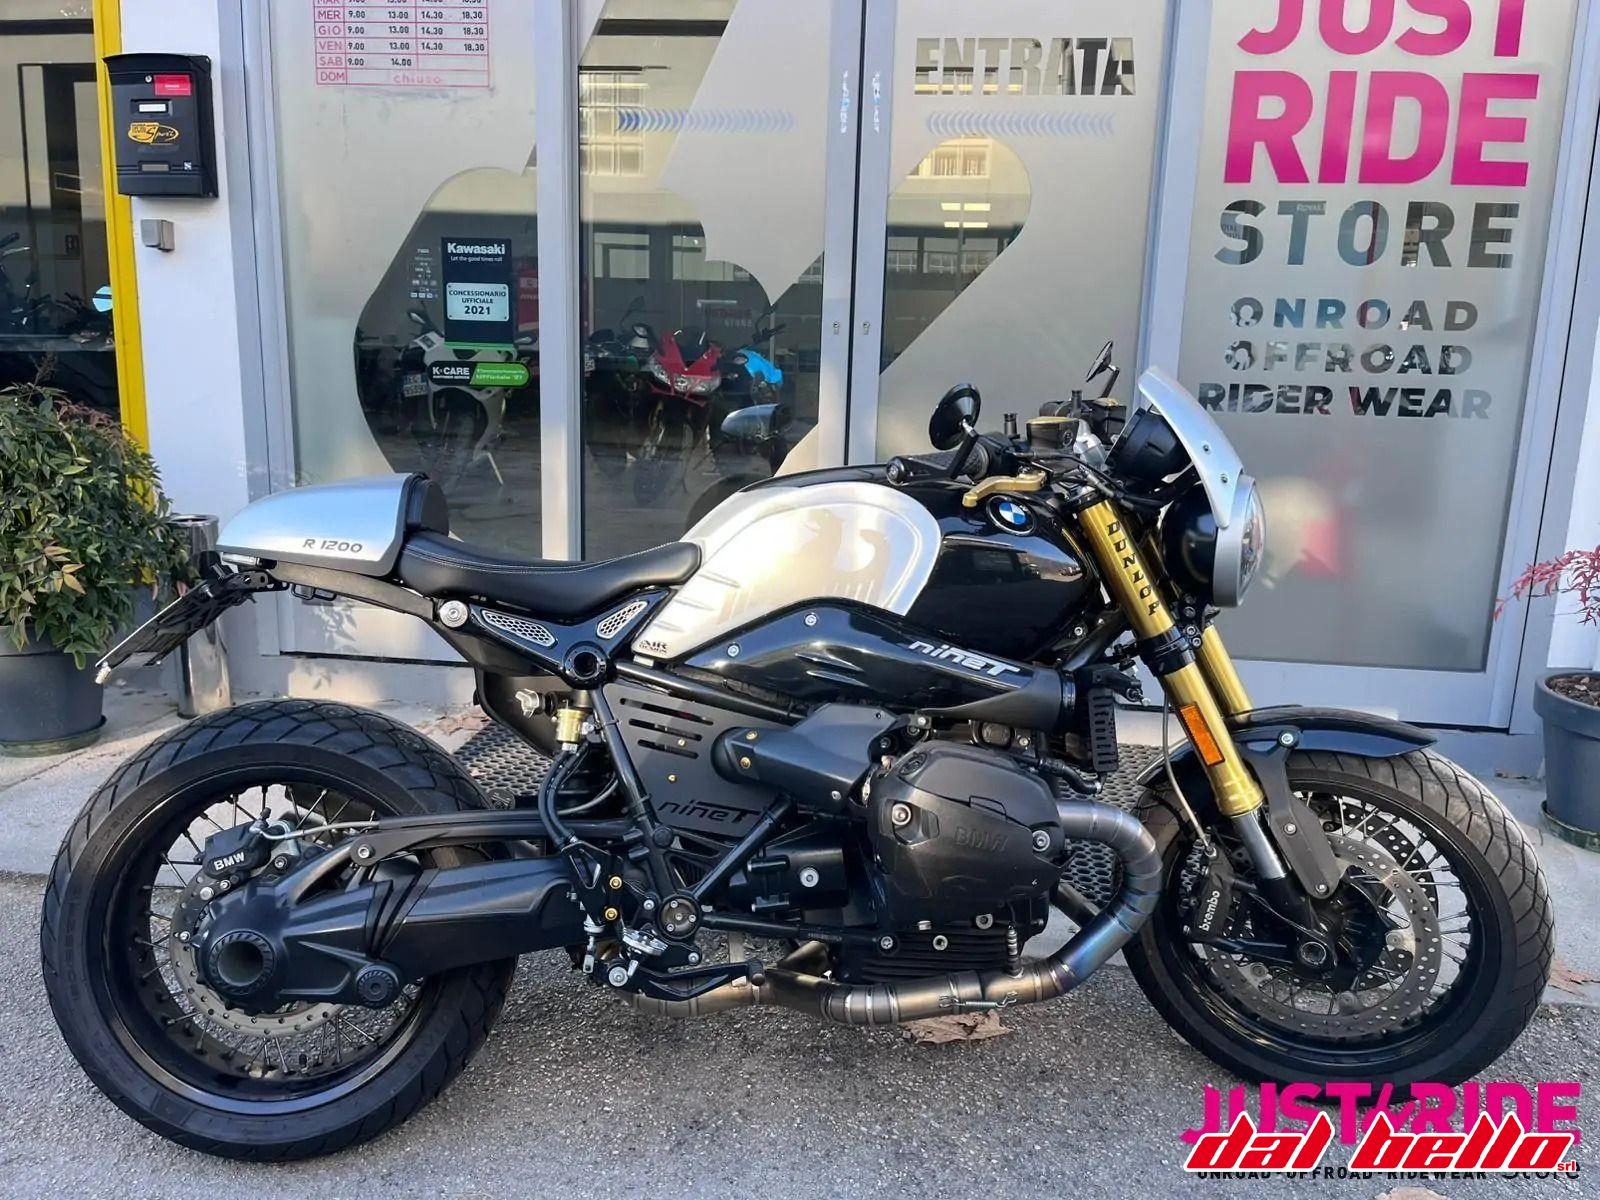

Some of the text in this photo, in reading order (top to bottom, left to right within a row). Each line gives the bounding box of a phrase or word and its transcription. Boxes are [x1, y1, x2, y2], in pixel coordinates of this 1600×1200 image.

[317, 10, 341, 19] MER
[318, 25, 341, 35] GIO
[319, 41, 342, 50] VEN
[319, 56, 343, 66] SAB
[914, 37, 1136, 96] ENTRATA
[320, 71, 345, 81] DOM
[1223, 70, 1540, 187] RIDE
[1213, 199, 1520, 268] STORE
[447, 242, 506, 255] Kawasaki
[449, 289, 507, 298] CONCESSIONARIO
[464, 305, 491, 315] 2021
[1230, 297, 1478, 332] ONROAD
[1224, 340, 1472, 376] OFFROAD
[1198, 382, 1492, 420] RIDER WEAR
[302, 538, 363, 553] R 1200
[1106, 521, 1160, 616] DUNLOP
[213, 851, 245, 871] BMW
[1198, 890, 1220, 932] brembo
